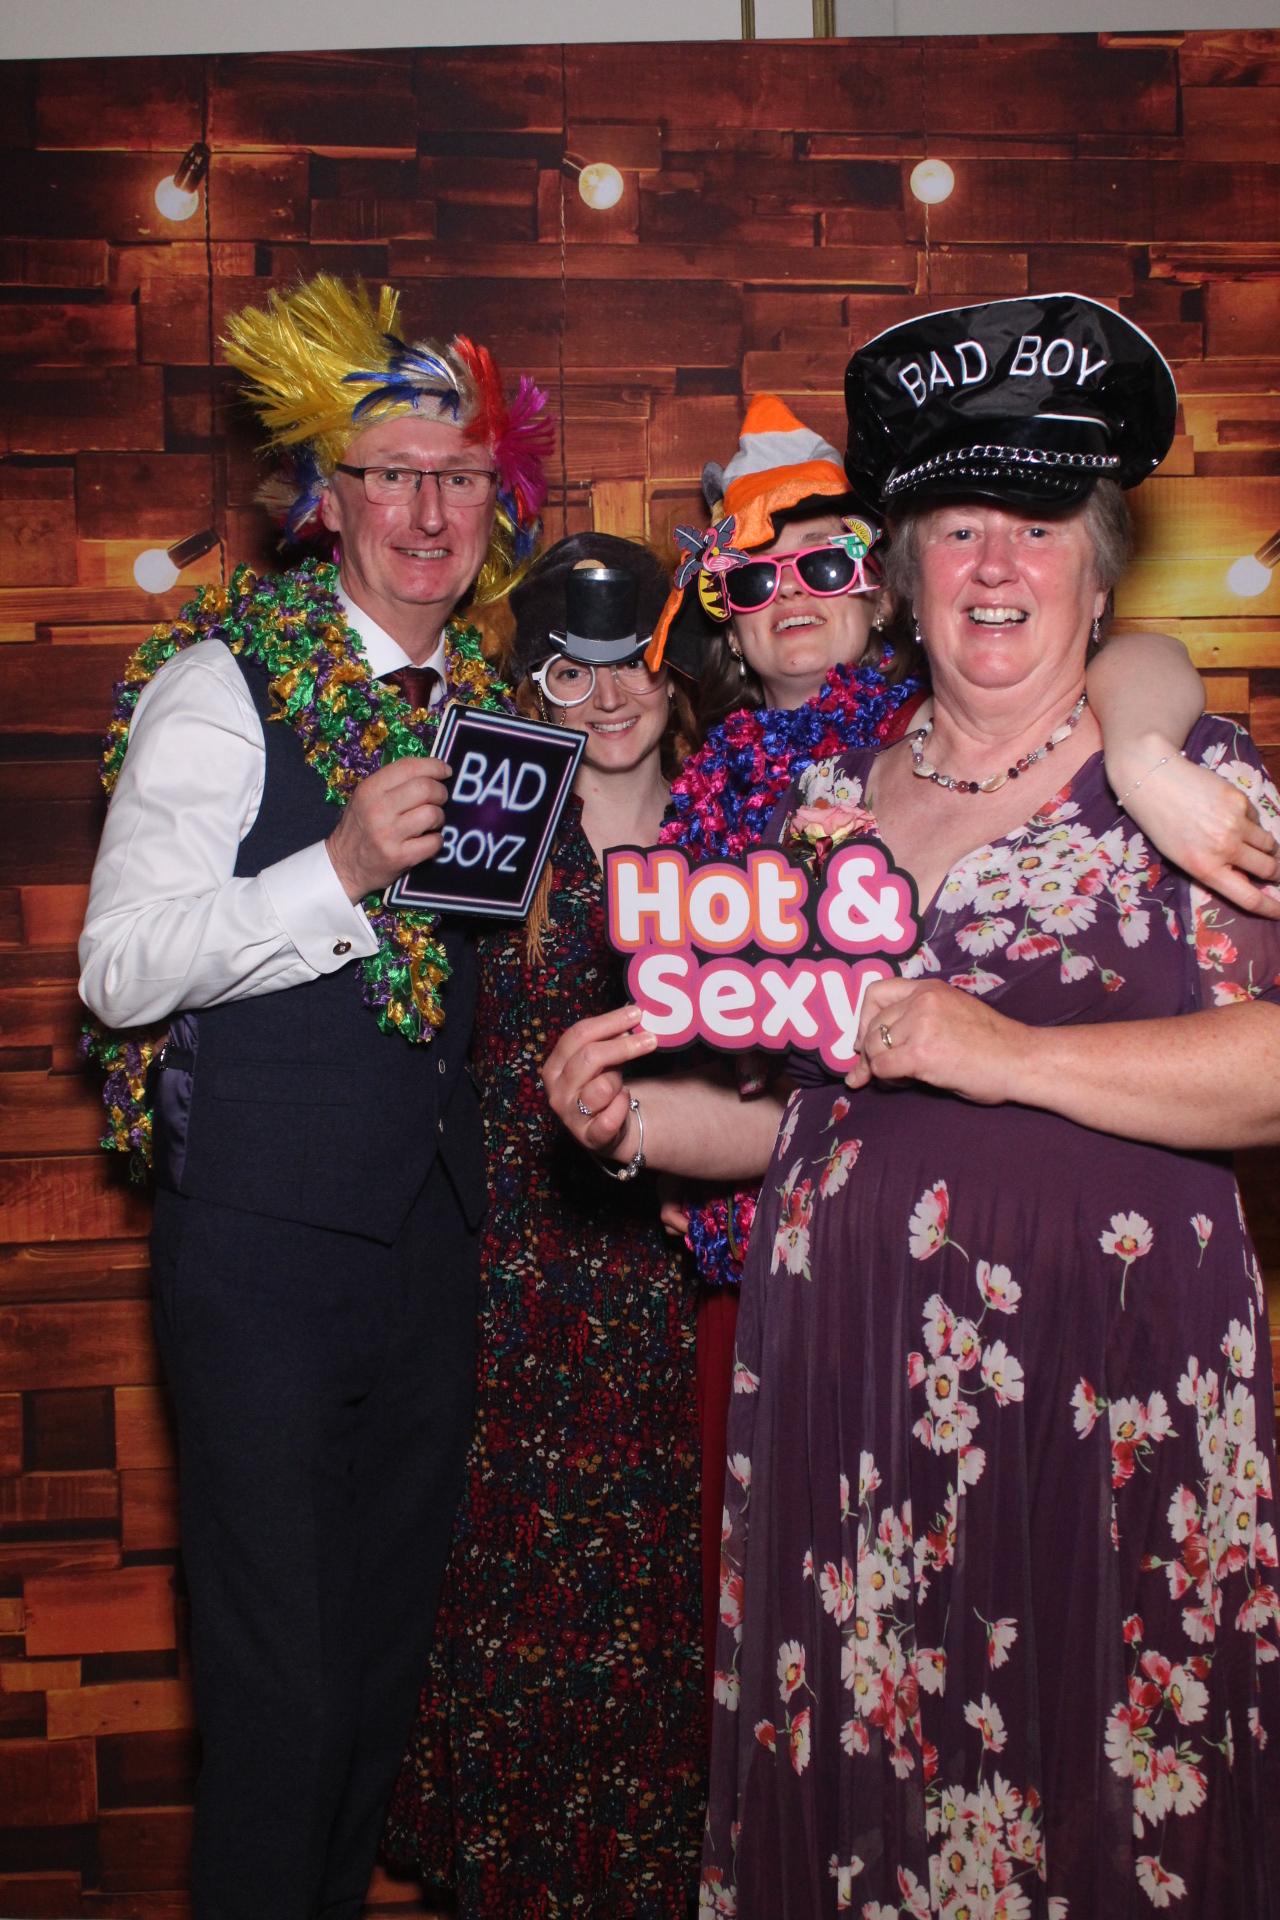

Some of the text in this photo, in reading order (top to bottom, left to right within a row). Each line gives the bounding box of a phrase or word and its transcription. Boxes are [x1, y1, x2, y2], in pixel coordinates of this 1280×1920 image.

[898, 335, 1107, 408] BAD BOY
[452, 751, 547, 812] BAD
[436, 825, 526, 873] BOYZ
[617, 857, 905, 942] Hot &
[637, 953, 883, 1061] Sexy
